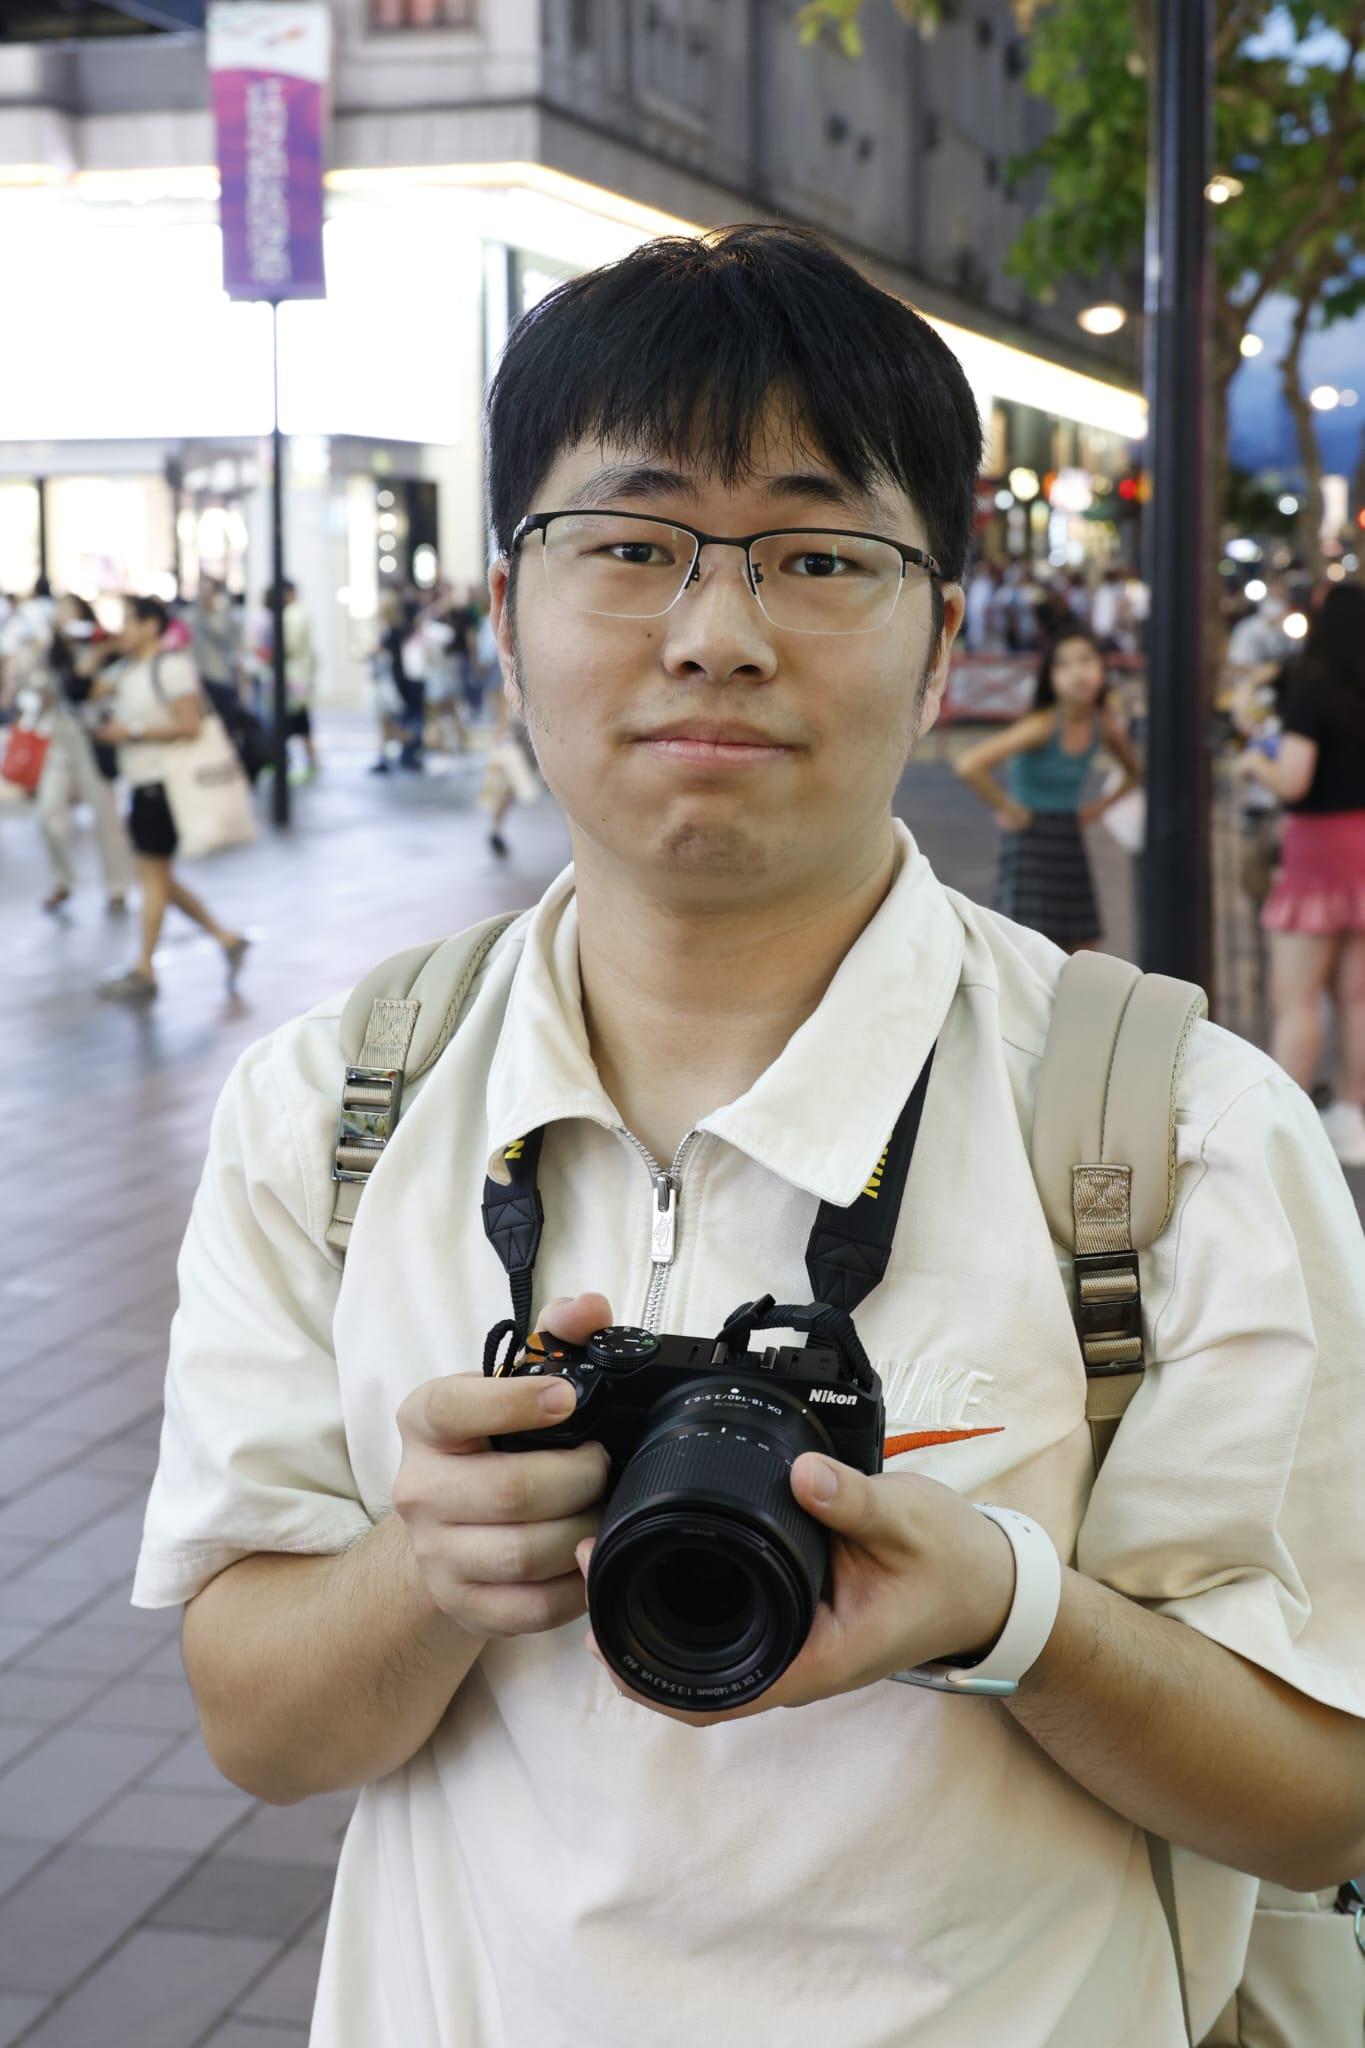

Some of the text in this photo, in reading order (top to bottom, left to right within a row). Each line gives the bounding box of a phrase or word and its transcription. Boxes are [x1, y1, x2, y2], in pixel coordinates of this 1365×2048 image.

[809, 1389, 858, 1405] Nikon
[767, 1403, 783, 1415] DX
[640, 1669, 653, 1681] VR
[743, 1676, 756, 1687] DX
[697, 1682, 741, 1696] 18-140mm
